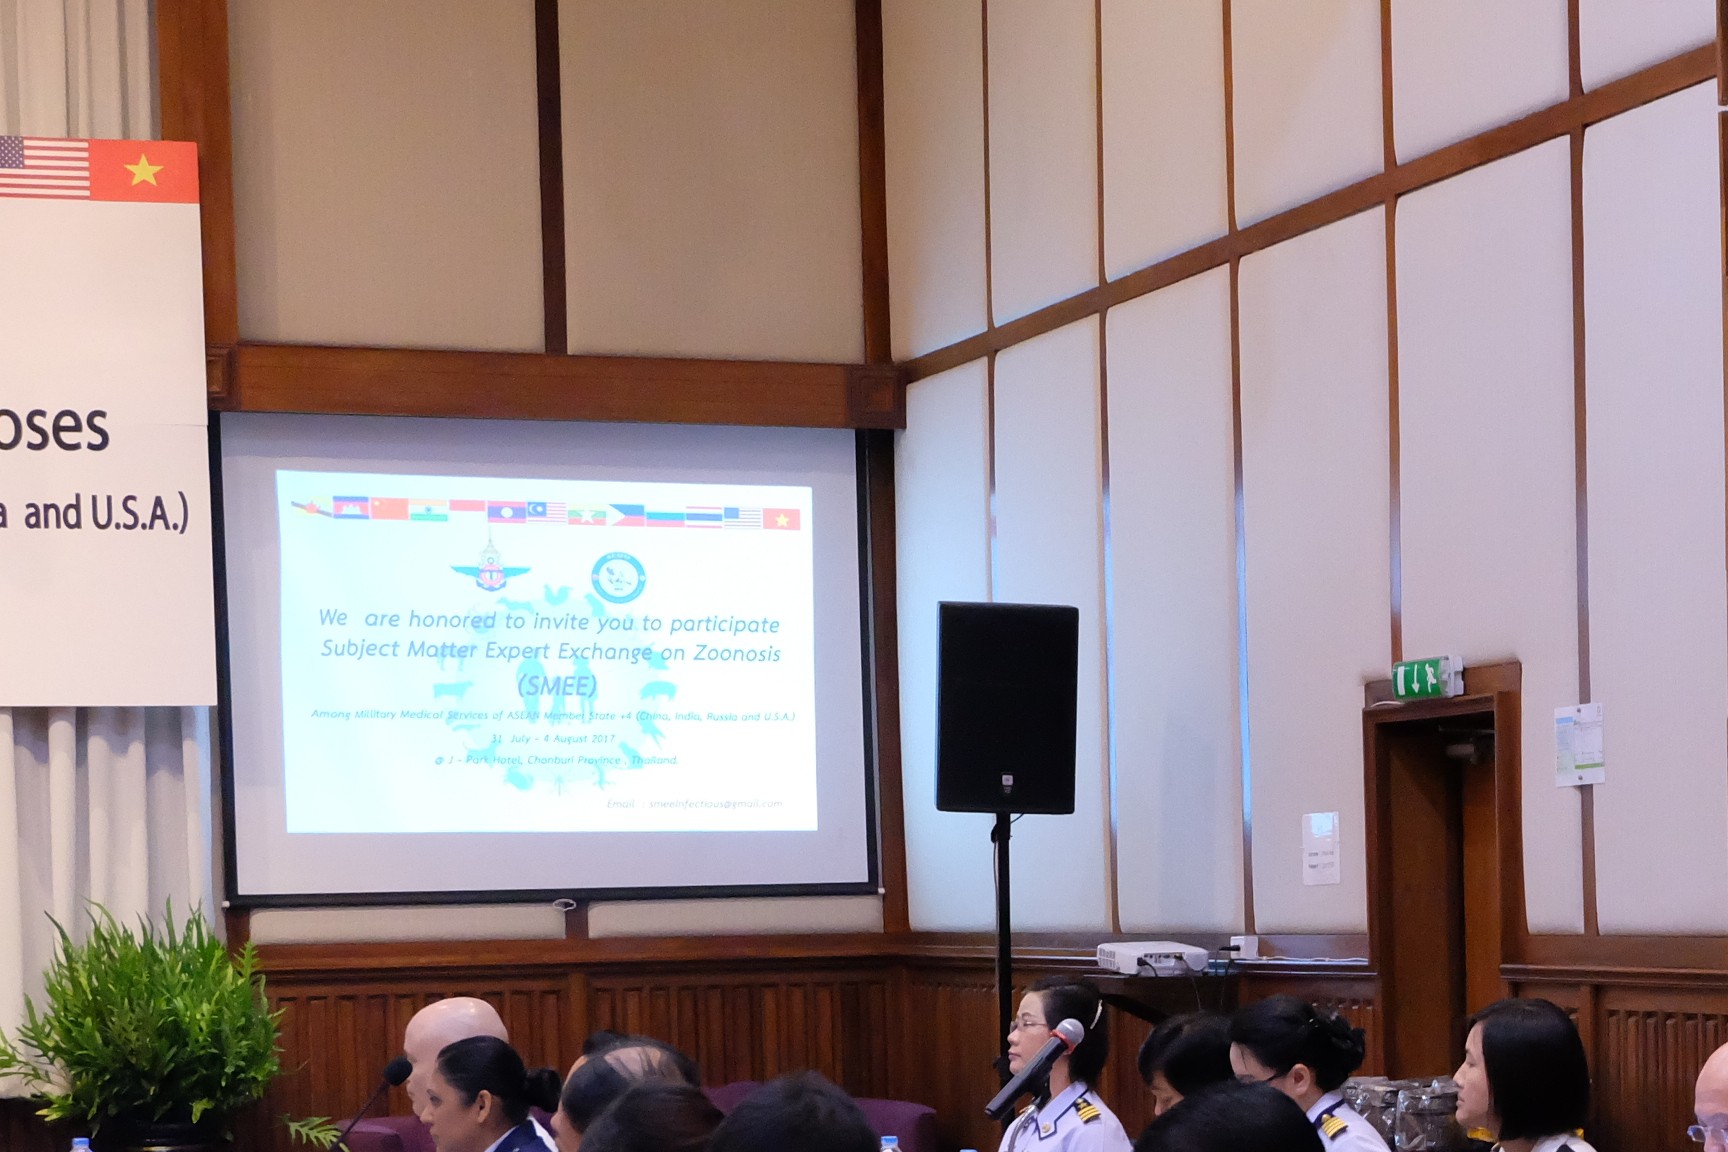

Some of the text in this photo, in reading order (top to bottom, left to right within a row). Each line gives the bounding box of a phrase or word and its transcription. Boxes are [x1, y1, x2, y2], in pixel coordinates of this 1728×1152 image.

[24, 492, 83, 530] and
[91, 490, 190, 535] U.S.A.)
[319, 608, 781, 636] We are honored to invite you to participate
[320, 638, 782, 665] Subject Matter Expert Exchange on Zoonosis
[517, 672, 598, 699] (SMEE)
[310, 708, 352, 721] Among
[399, 709, 444, 720] Medical
[447, 709, 489, 721] Services
[492, 709, 505, 720] of
[507, 710, 540, 721] ASEAN
[543, 711, 585, 722] Member
[588, 711, 616, 722] State
[706, 712, 739, 722] Russia
[741, 712, 761, 722] and
[763, 712, 797, 723] U.S.A.)
[490, 733, 503, 745] 31
[510, 733, 532, 745] July
[542, 734, 550, 743] 4
[553, 734, 588, 745] August
[591, 733, 616, 744] 2017
[465, 755, 490, 765] Park
[492, 755, 524, 766] Hotel,
[577, 755, 621, 765] Province
